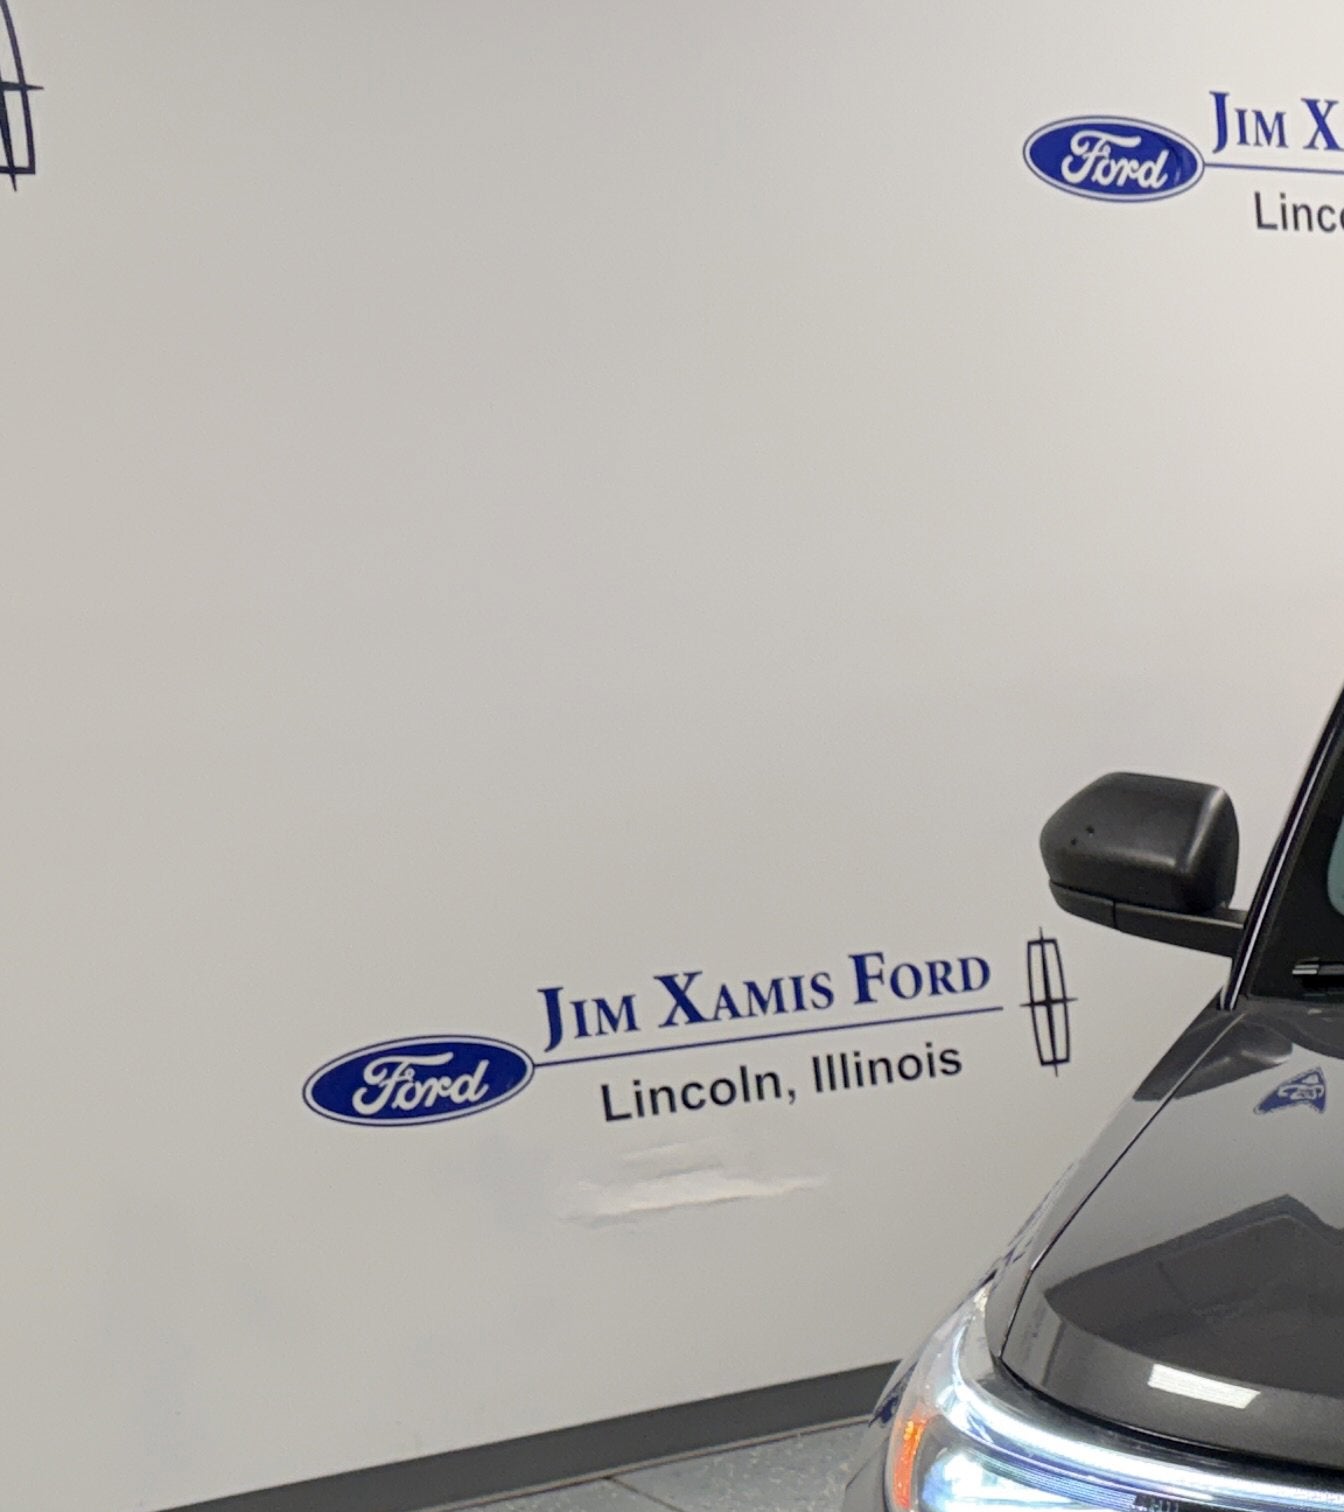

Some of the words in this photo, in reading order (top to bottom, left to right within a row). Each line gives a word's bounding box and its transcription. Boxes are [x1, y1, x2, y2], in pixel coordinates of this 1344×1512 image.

[1208, 90, 1288, 154] JIM
[1060, 129, 1169, 188] Ford
[536, 985, 639, 1053] JIM
[652, 970, 835, 1030] XAMIS
[846, 951, 992, 1005] FORD
[352, 1052, 490, 1116] Ford
[599, 1064, 798, 1122] Lincoln,
[811, 1041, 964, 1095] Illinois
